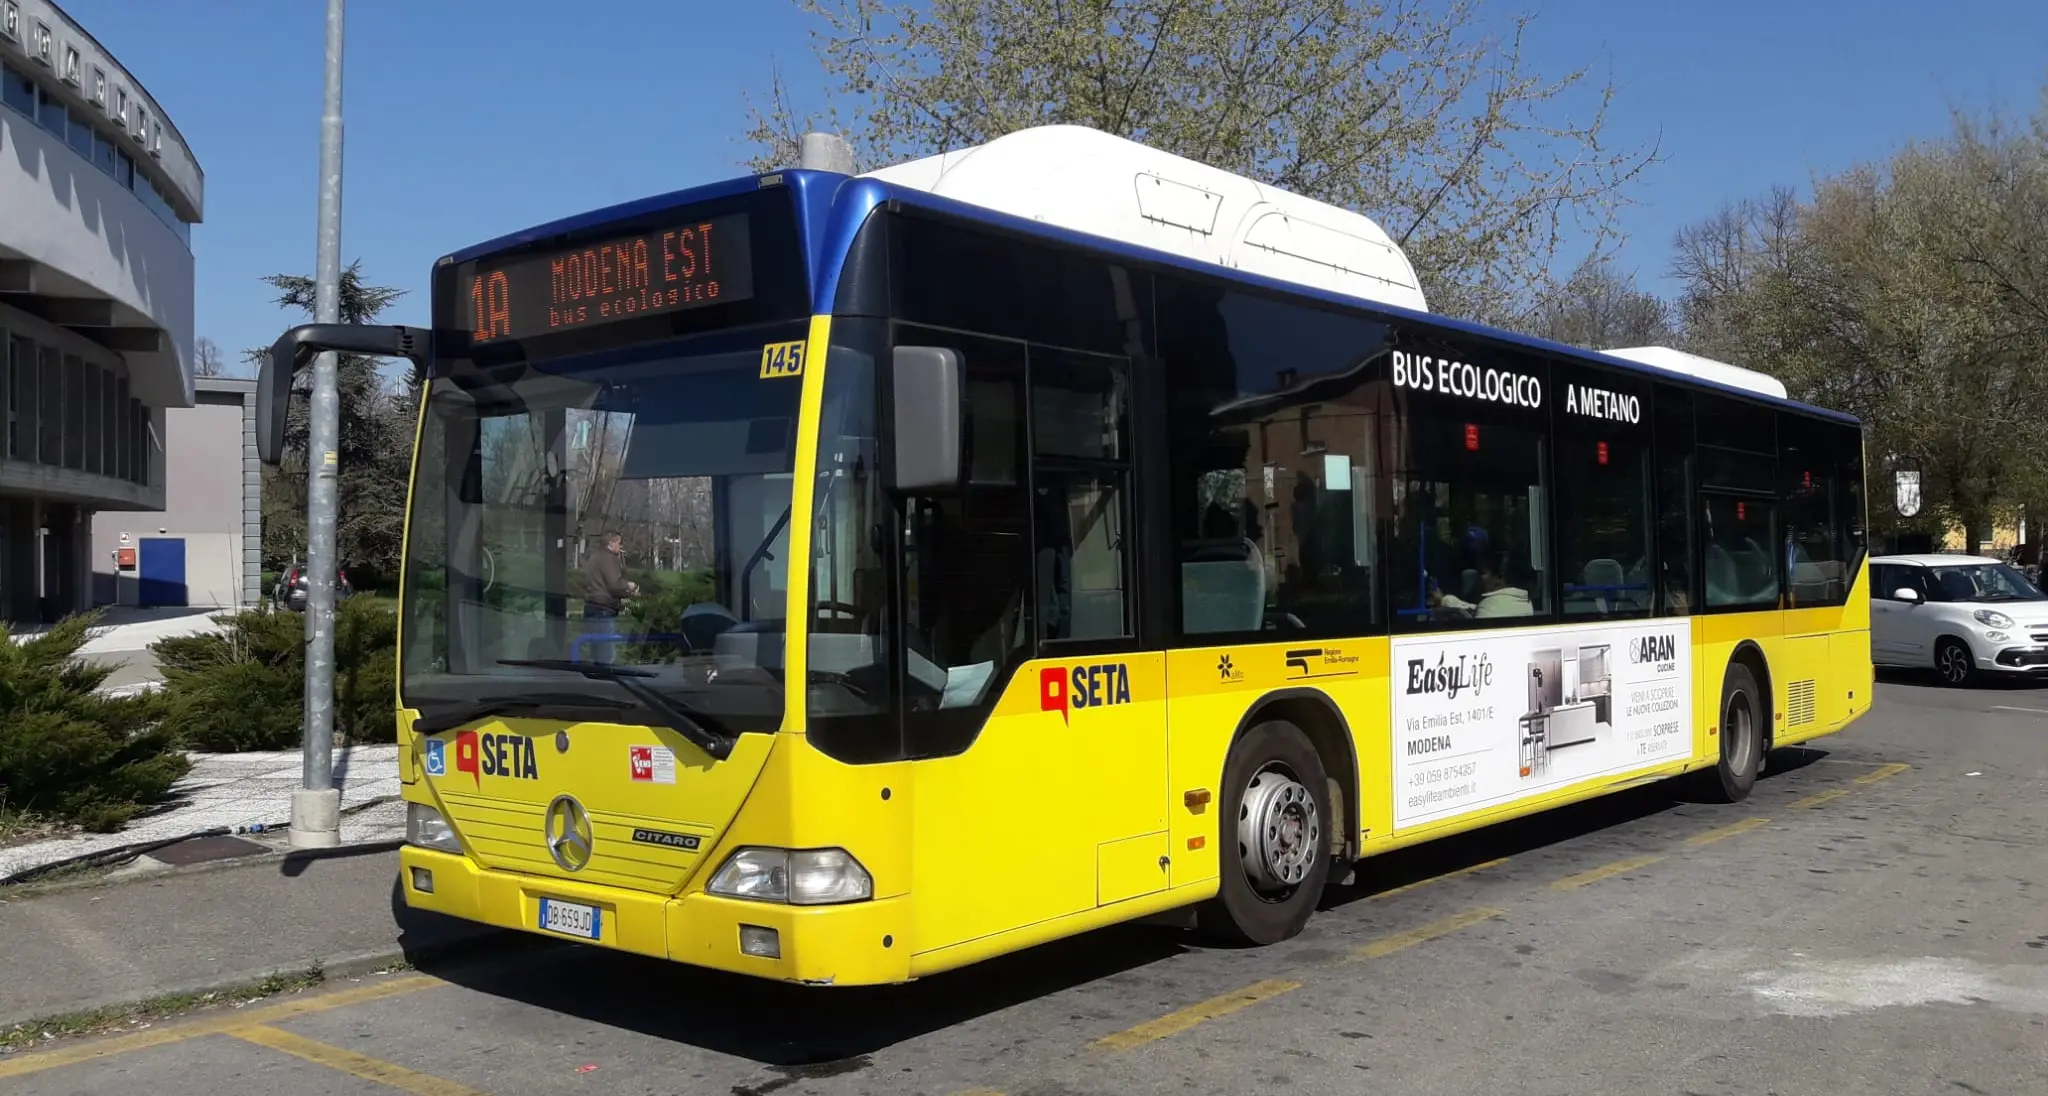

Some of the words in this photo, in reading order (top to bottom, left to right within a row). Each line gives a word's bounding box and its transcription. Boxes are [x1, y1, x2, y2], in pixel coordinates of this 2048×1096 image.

[551, 238, 648, 305] MODENA
[662, 223, 713, 282] EST
[471, 270, 511, 341] 1A
[549, 305, 588, 328] bus
[599, 281, 721, 318] ecologico
[765, 344, 801, 374] 145
[1393, 350, 1434, 392] BUS
[1437, 358, 1541, 409] ECOLOGICO
[1566, 384, 1578, 414] A
[1580, 386, 1641, 424] METANO
[1639, 634, 1676, 663] ARAN
[1071, 663, 1132, 710] SETA
[1406, 717, 1420, 732] Via
[1422, 714, 1448, 730] Emilia
[1653, 720, 1679, 737] SORPRESE
[481, 732, 539, 780] SETA
[1407, 734, 1452, 757] MODENA
[634, 830, 698, 848] CITARO
